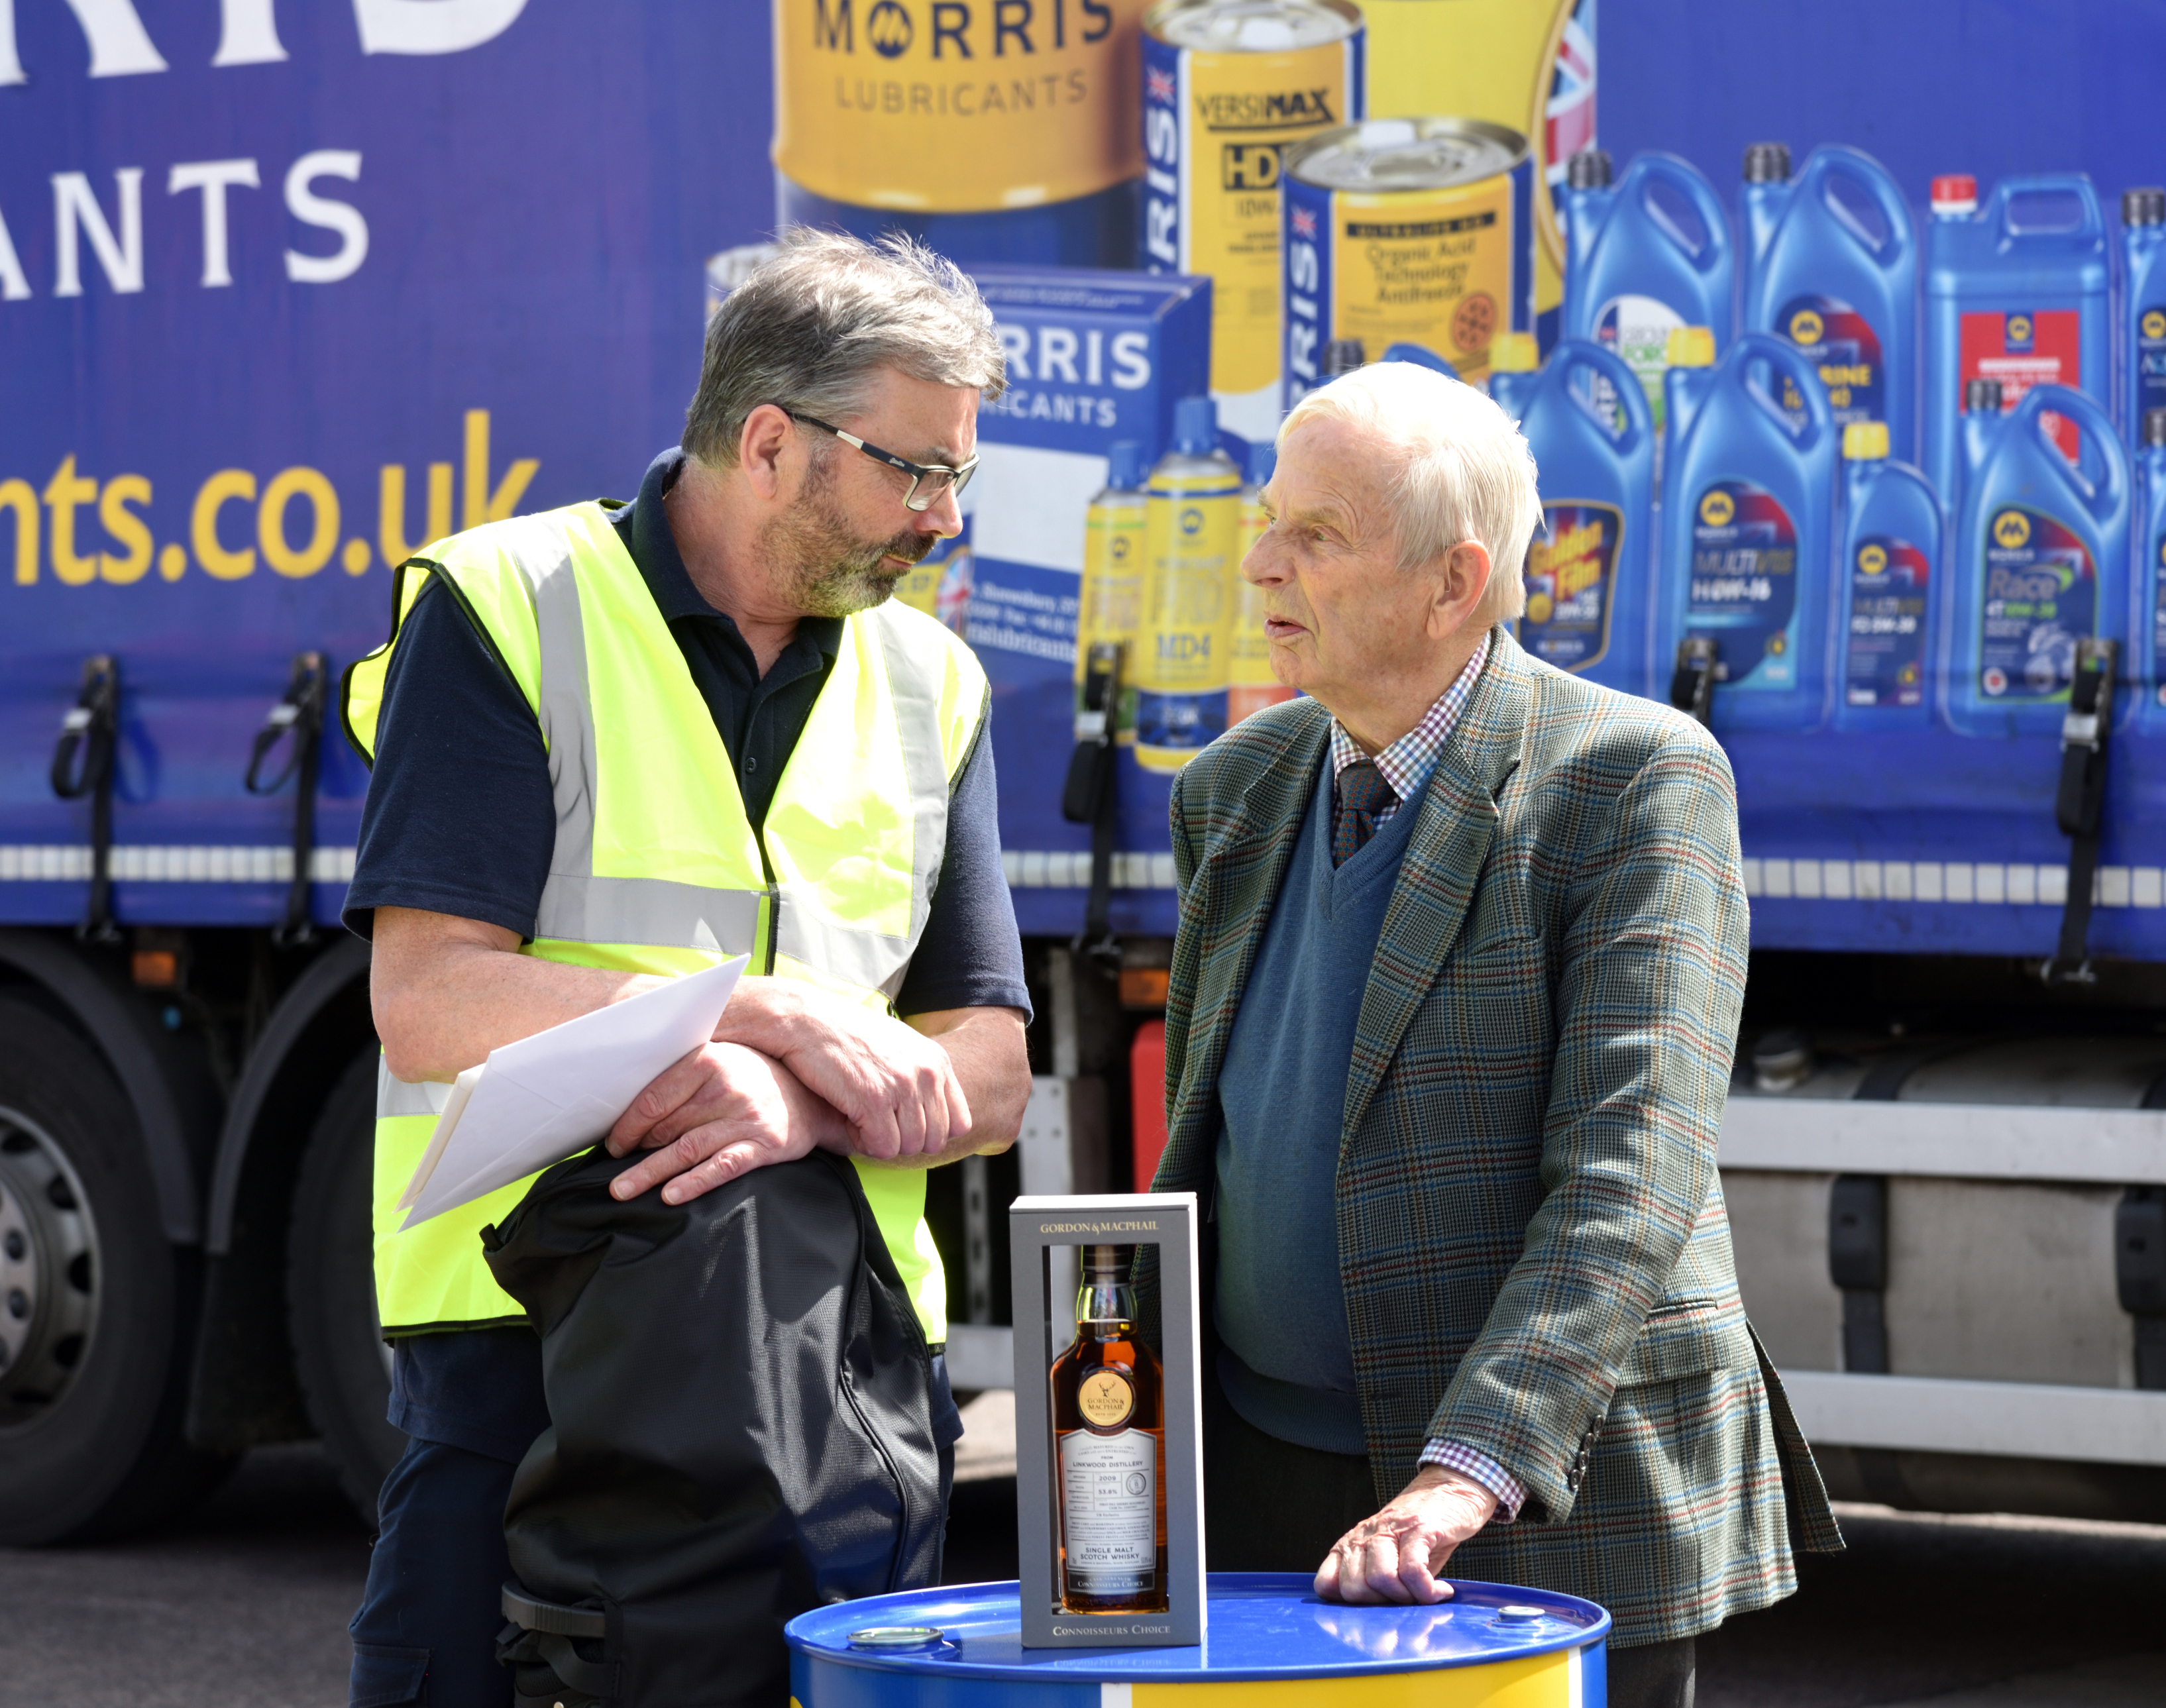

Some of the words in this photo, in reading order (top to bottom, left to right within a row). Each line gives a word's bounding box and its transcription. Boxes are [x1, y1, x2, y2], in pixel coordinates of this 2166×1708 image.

[813, 0, 1112, 60] MORRIS
[836, 69, 1088, 117] LUBRICANTS
[1193, 88, 1336, 123] VERSIMAX
[1147, 106, 1177, 276] RIS
[1365, 240, 1431, 266] Organic
[1438, 237, 1476, 257] Acid
[1374, 261, 1470, 286] Technology
[1291, 240, 1319, 405] RIS
[1988, 567, 2058, 600] Race
[1040, 1223, 1090, 1234] GORDON
[1101, 1221, 1159, 1232] MACPHAIL
